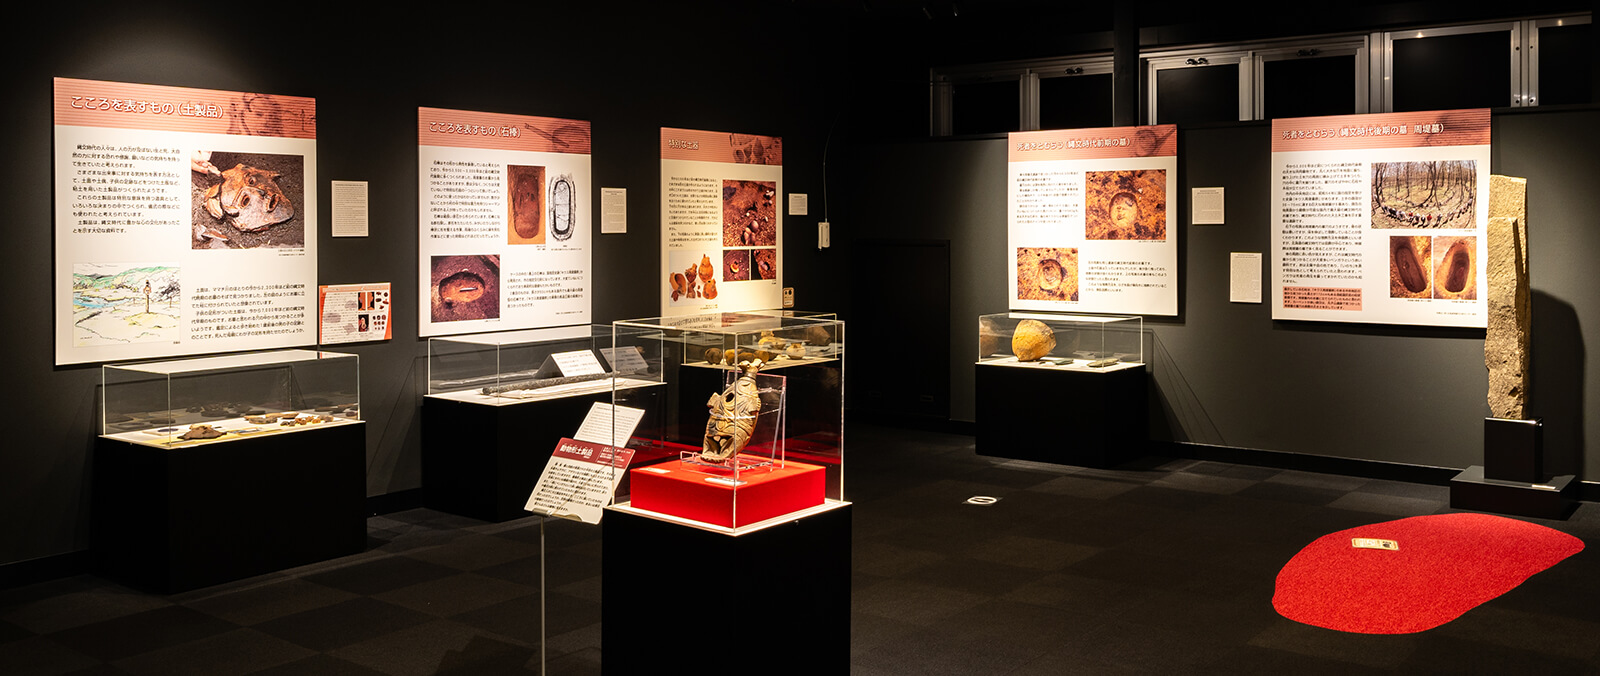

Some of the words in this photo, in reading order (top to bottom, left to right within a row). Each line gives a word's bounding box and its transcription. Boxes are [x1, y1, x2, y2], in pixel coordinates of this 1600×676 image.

[71, 96, 223, 118] こころを表すもの（土製品）
[429, 122, 521, 138] こころを表すもの（石棒）
